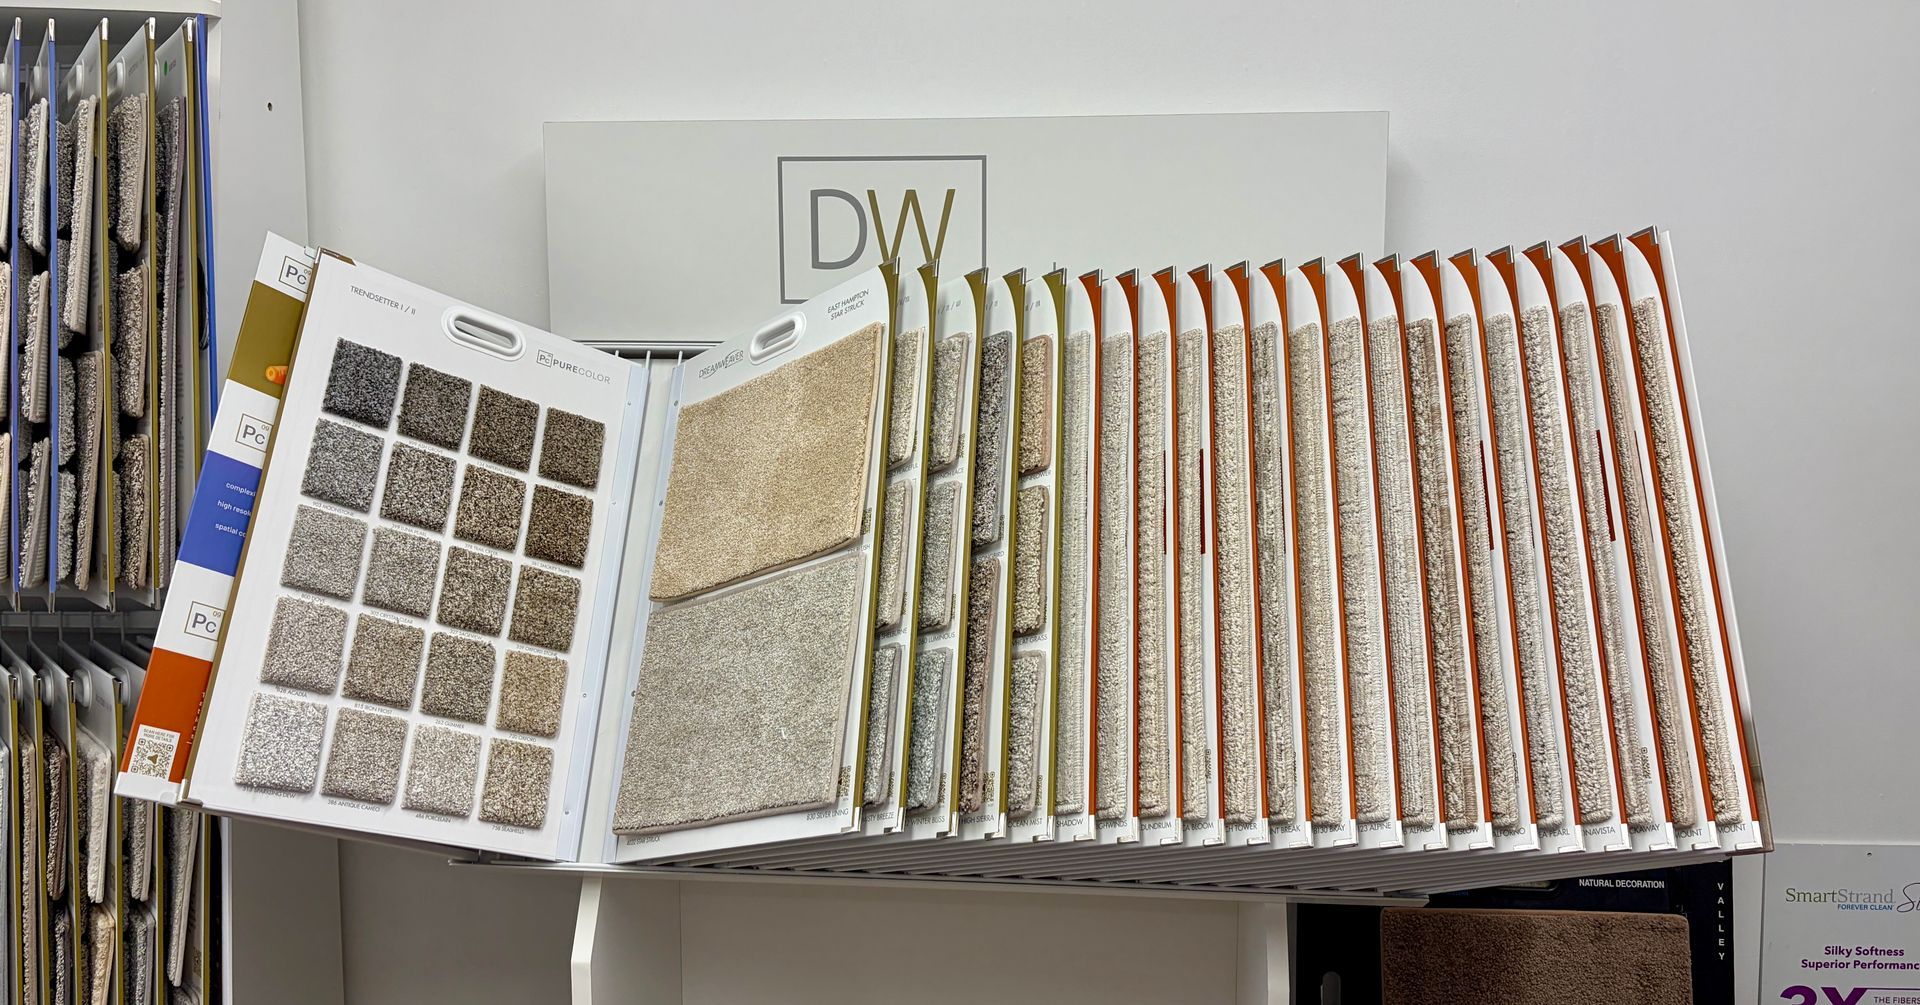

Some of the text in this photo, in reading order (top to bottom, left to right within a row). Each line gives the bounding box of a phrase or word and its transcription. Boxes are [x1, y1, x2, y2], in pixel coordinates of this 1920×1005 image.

[810, 188, 956, 268] DW
[350, 285, 399, 309] TRENDSETTER
[828, 289, 869, 313] EAST HAMPTON
[831, 300, 864, 320] STAR STRUCK
[553, 359, 610, 384] PURECOLOR
[261, 424, 270, 432] 09
[217, 500, 232, 511] high
[215, 523, 238, 535] spatial
[212, 610, 221, 618] 09
[816, 810, 831, 820] SILVER
[832, 808, 849, 818] LINING
[877, 811, 894, 820] BREEZE
[976, 815, 995, 824] SIERRA
[1008, 818, 1043, 828] OCEAN MIST
[1056, 818, 1084, 828] SHADOW
[1141, 821, 1172, 831] DUNDRUM
[1191, 822, 1214, 831] BLOOM
[1234, 823, 1258, 832] TOWER
[1280, 825, 1301, 834] BREAK
[1329, 824, 1346, 833] BRAY
[1369, 822, 1392, 831] ALPINE
[1410, 825, 1435, 834] ALPACA
[1458, 826, 1479, 835] GLOW
[1717, 824, 1746, 834] MOUNT
[1549, 829, 1571, 838] PEARL
[1578, 878, 1665, 889] NATURAL DECORATION
[1785, 887, 1895, 904] SmartStrand
[1717, 882, 1725, 961] VALLEY
[1824, 946, 1905, 958] Silky Softness
[1801, 959, 1851, 971] Superior
[1873, 996, 1891, 1004] THE
